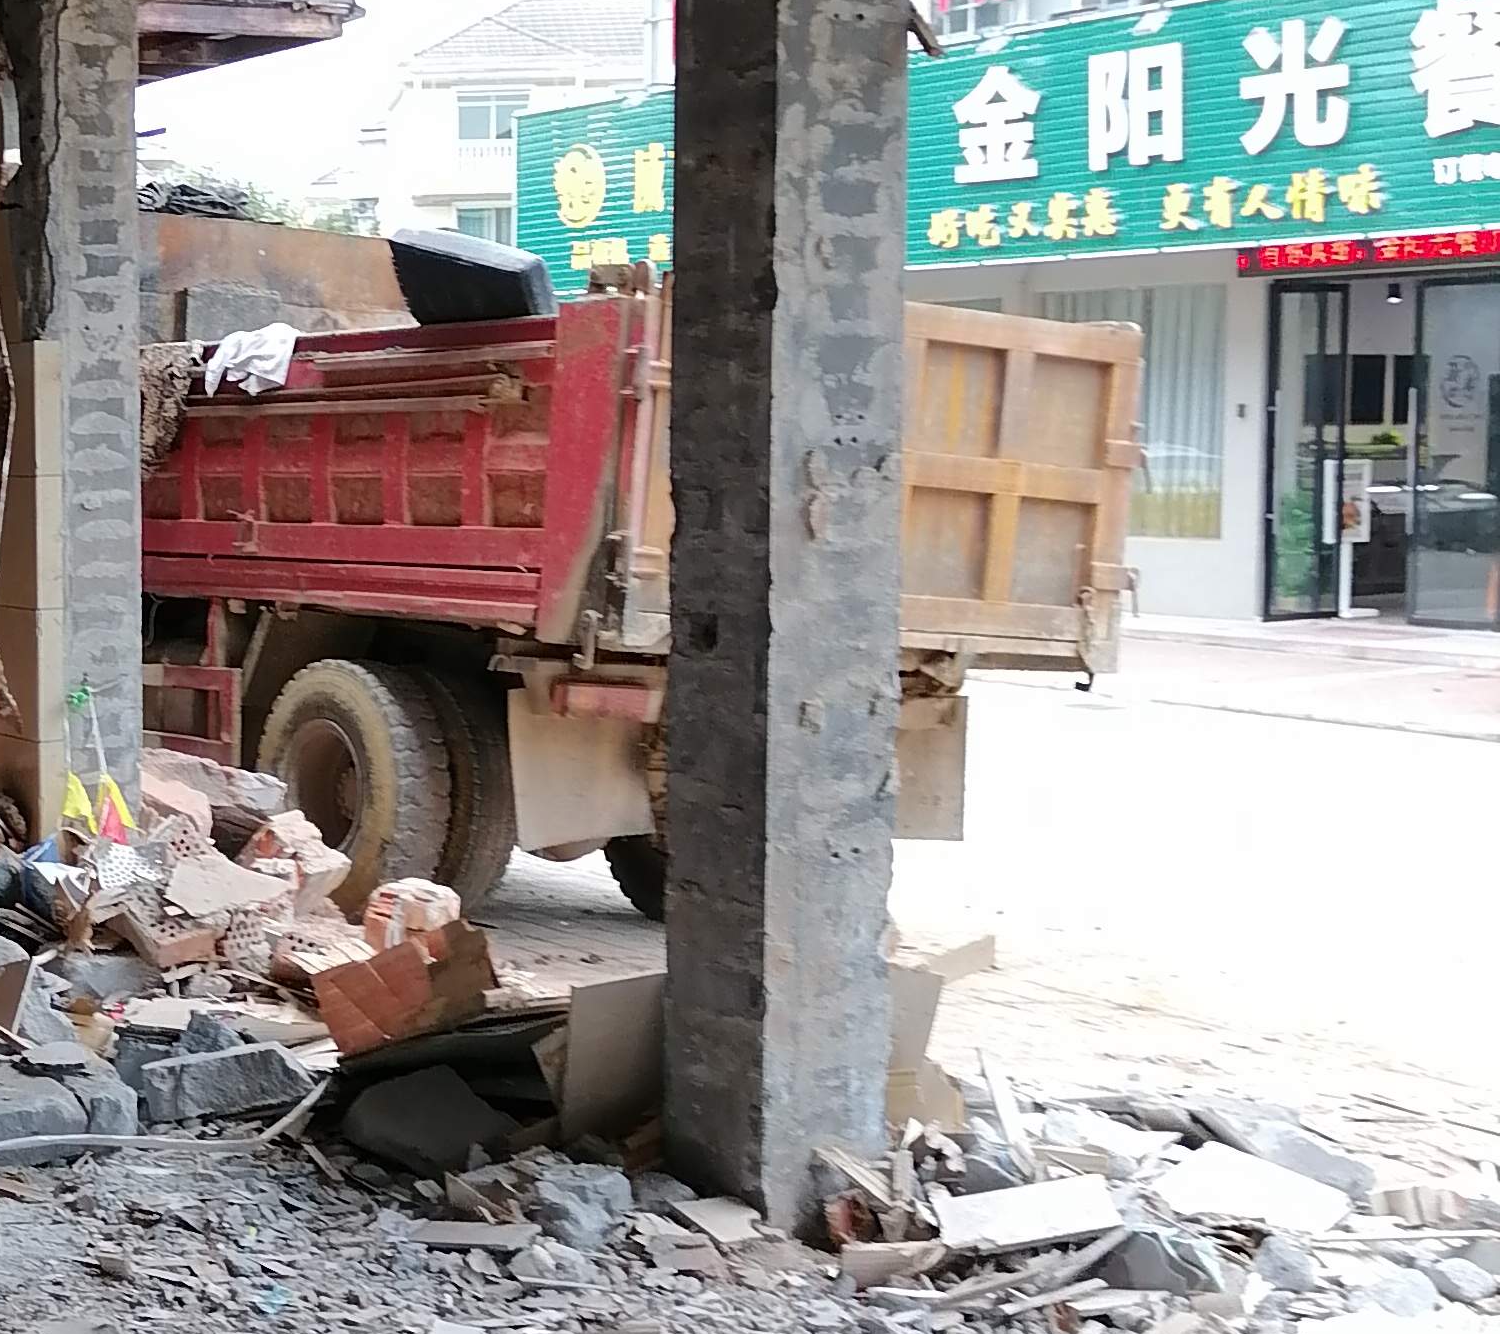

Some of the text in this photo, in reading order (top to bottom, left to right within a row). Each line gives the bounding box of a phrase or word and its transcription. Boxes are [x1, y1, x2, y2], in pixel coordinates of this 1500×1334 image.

[1159, 164, 1384, 231] 更有人情味
